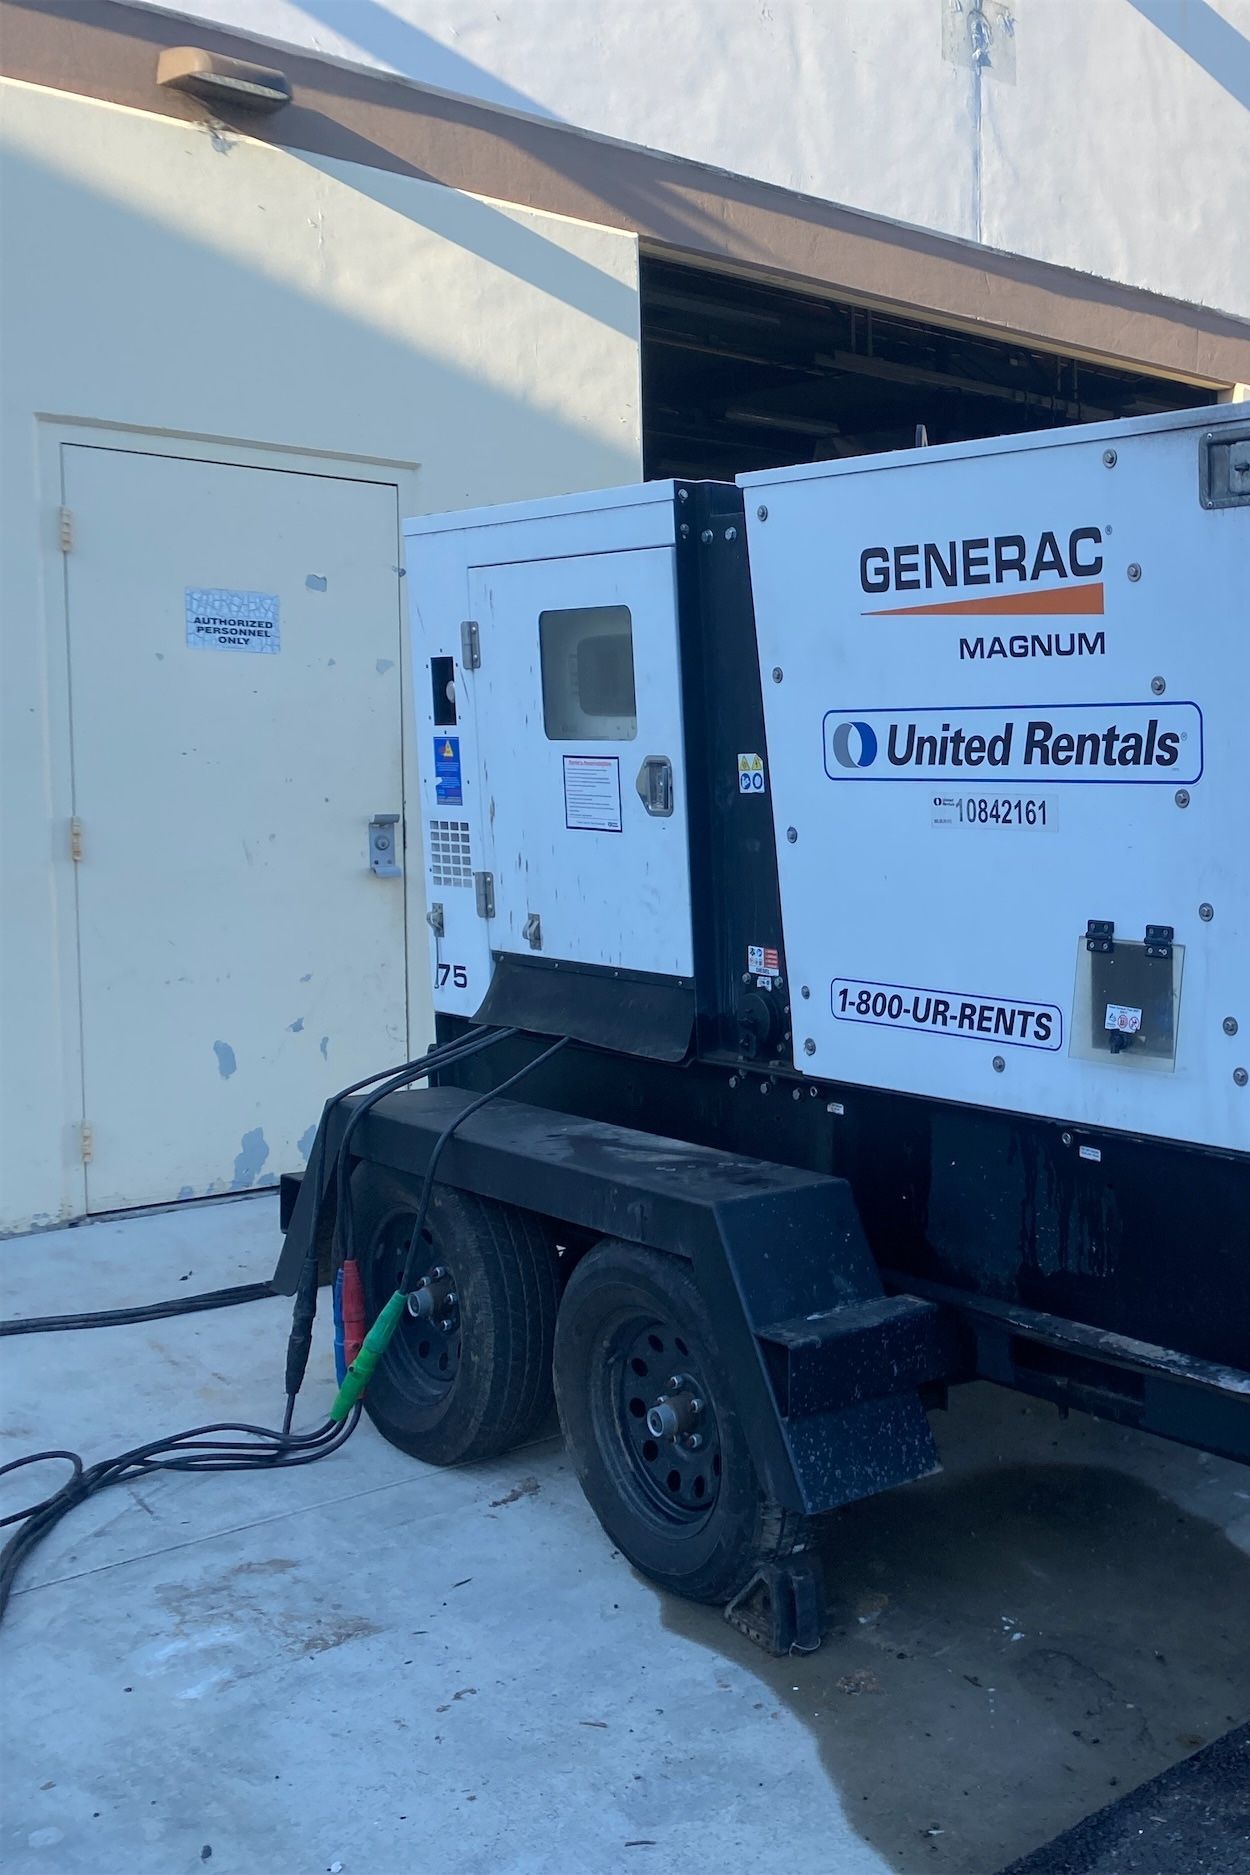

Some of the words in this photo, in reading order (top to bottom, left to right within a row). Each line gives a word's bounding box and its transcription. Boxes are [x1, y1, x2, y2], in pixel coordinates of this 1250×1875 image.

[860, 526, 1103, 593] GENERAC
[193, 617, 273, 629] AUTHORIZED
[196, 626, 271, 638] PERSONNEL
[218, 636, 250, 645] ONLY
[959, 631, 1105, 660] MAGNUM
[886, 722, 1013, 766] United
[1023, 719, 1180, 768] Rentals
[955, 798, 1046, 825] 10842161
[438, 963, 467, 989] 75
[838, 988, 1052, 1041] 1-800-UR-RENTS
